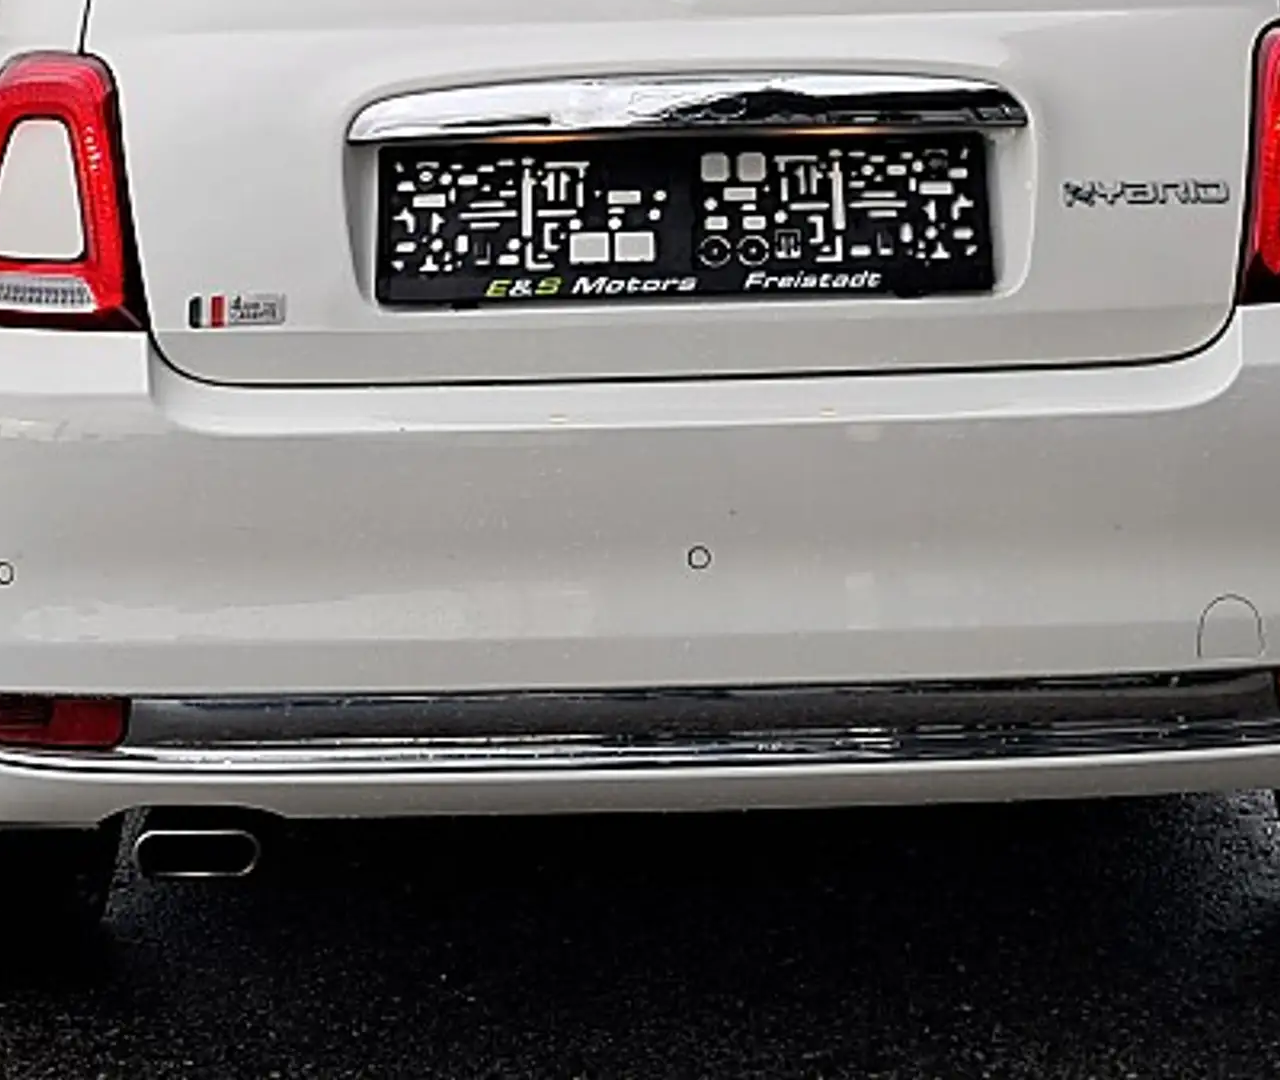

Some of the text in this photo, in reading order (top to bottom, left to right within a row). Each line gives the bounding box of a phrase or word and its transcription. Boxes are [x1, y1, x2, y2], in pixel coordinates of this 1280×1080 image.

[484, 270, 883, 298] E&S Motors Freistadt
